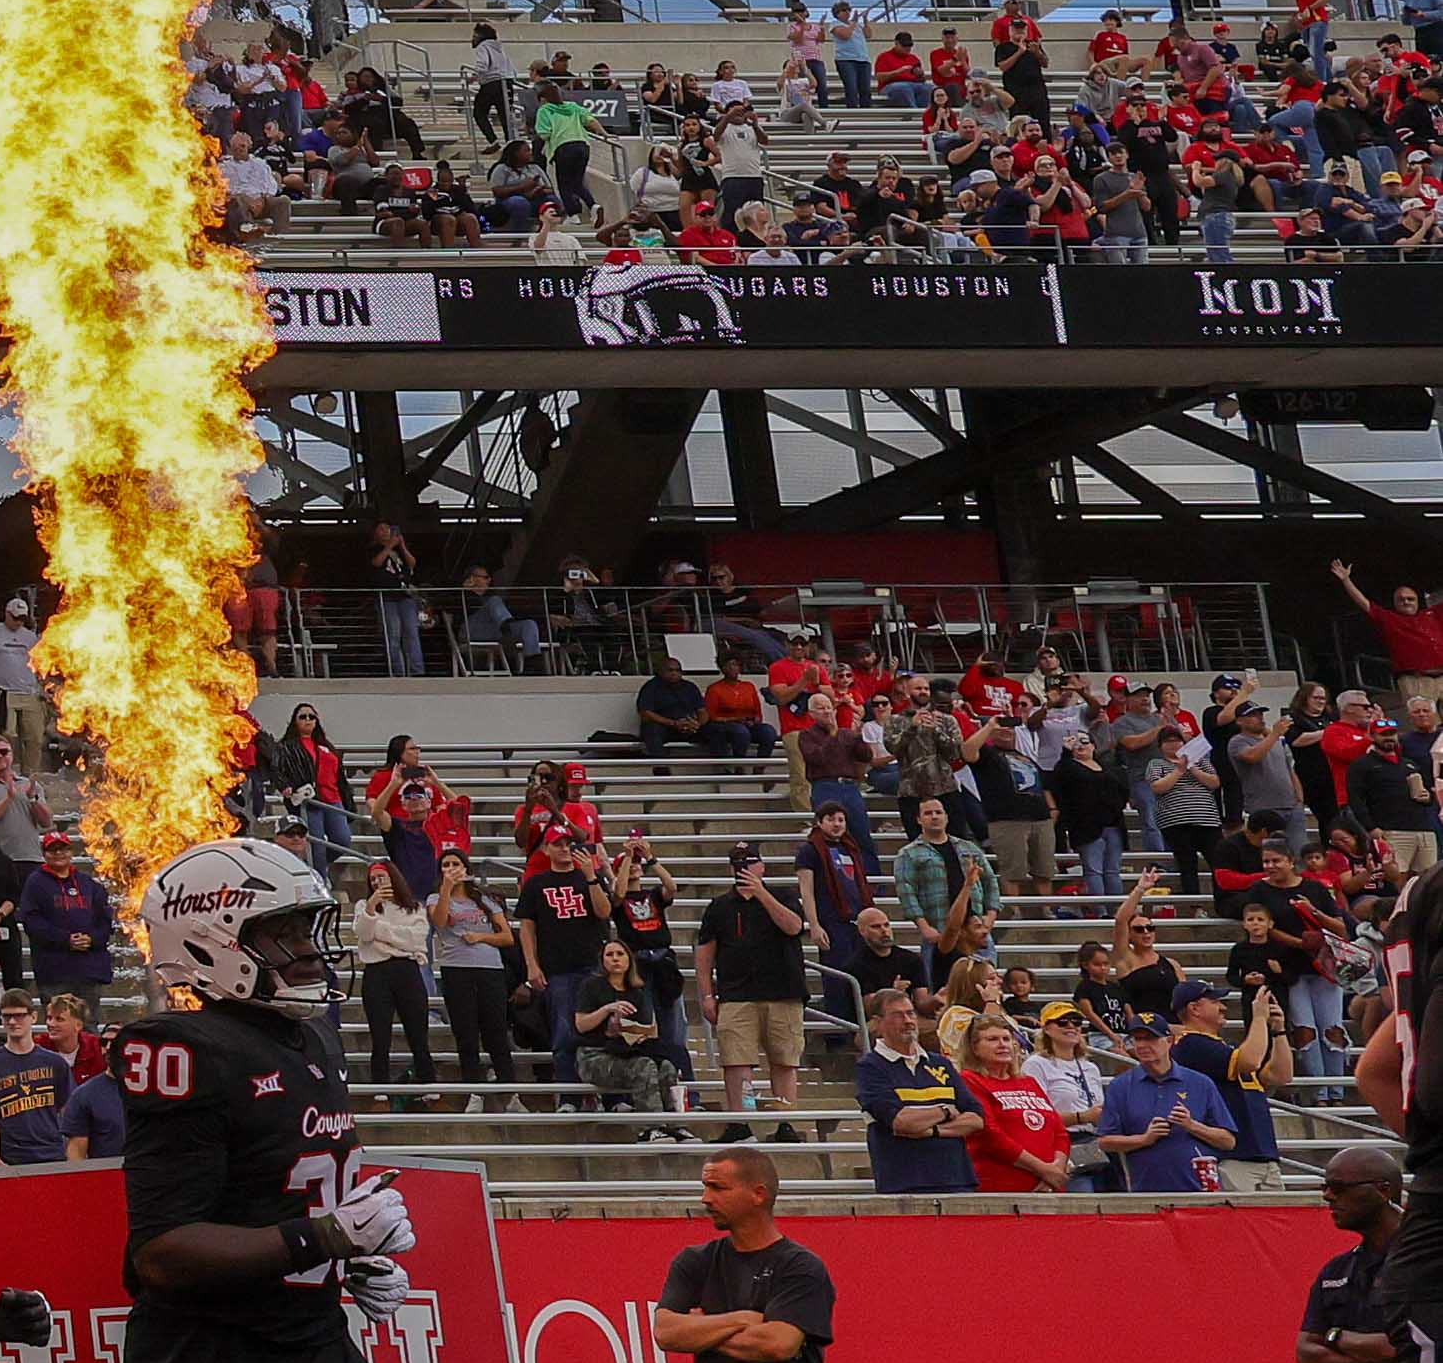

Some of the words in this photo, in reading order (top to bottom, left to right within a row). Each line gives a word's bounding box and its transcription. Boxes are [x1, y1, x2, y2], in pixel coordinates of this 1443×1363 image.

[583, 98, 618, 118] 227
[727, 276, 830, 299] UGARS
[872, 275, 1011, 298] HOUSTON
[266, 286, 371, 328] STON
[162, 883, 260, 923] Houston
[542, 885, 588, 919] UH
[122, 1041, 196, 1100] 30
